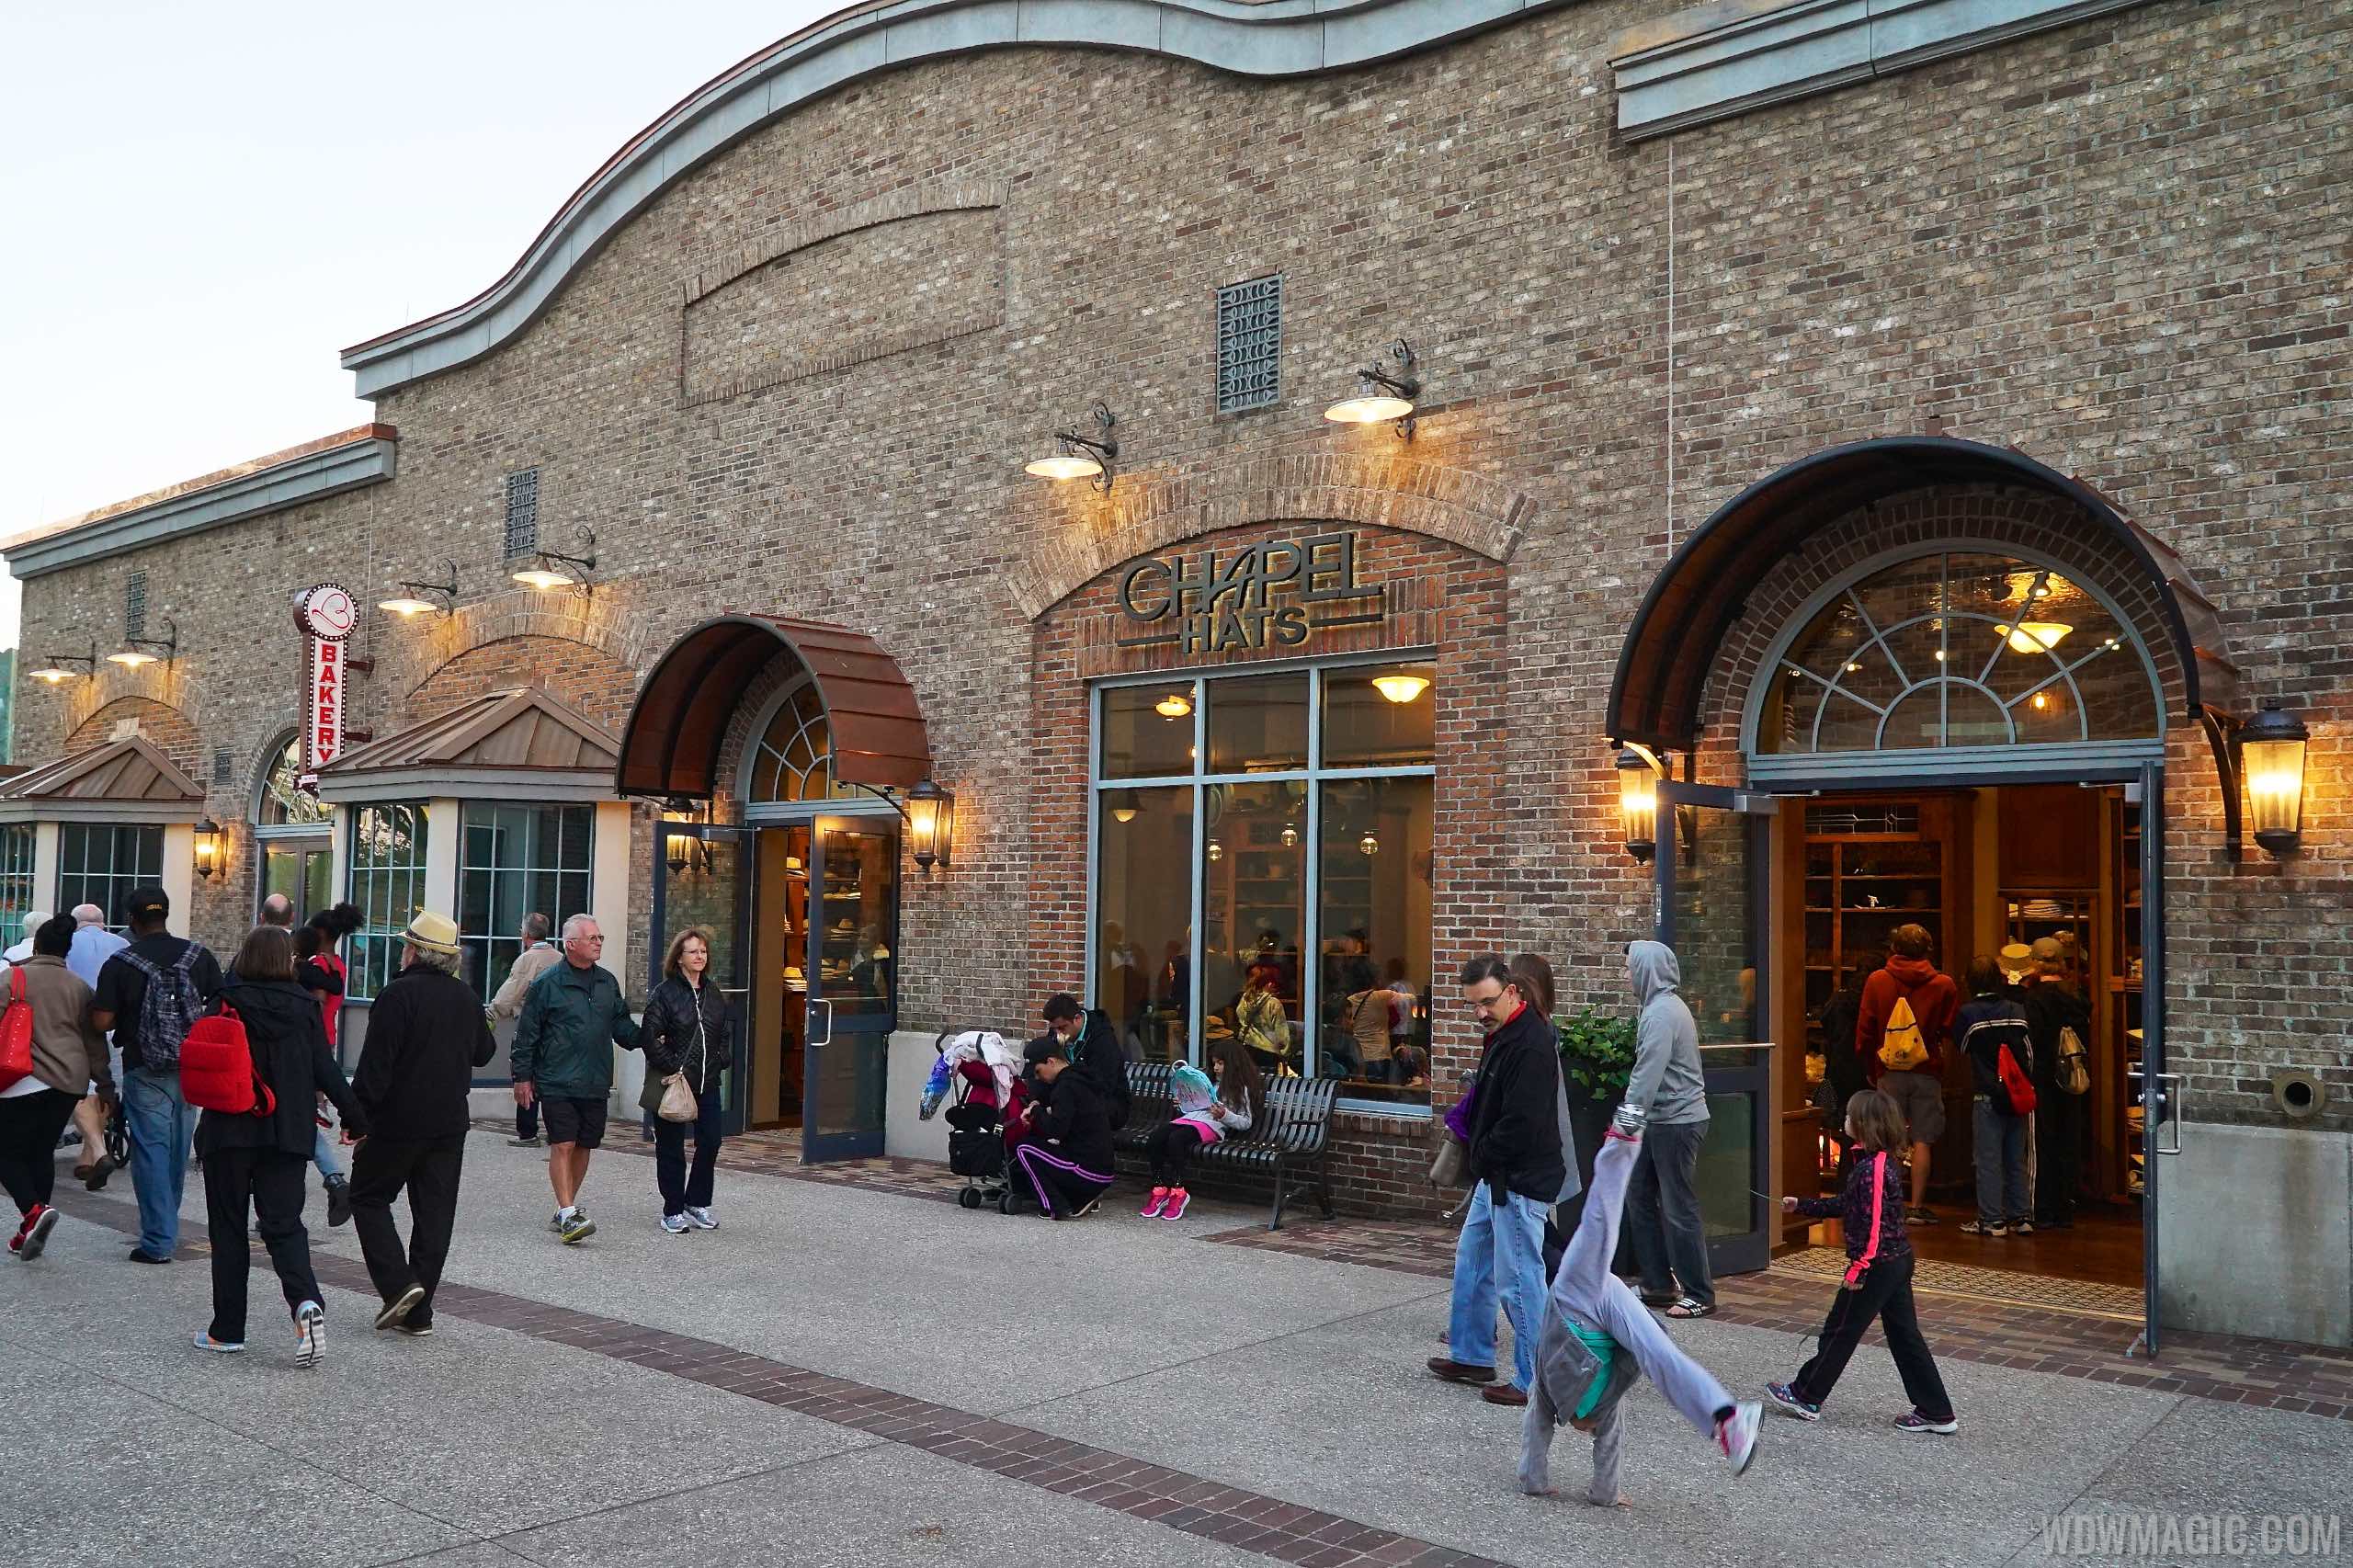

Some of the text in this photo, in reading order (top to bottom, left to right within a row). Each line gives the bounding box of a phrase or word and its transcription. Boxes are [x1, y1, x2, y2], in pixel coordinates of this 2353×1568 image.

[1118, 533, 1382, 621] CHAPEL
[1183, 607, 1308, 653] HATS
[317, 643, 337, 762] BAKERY
